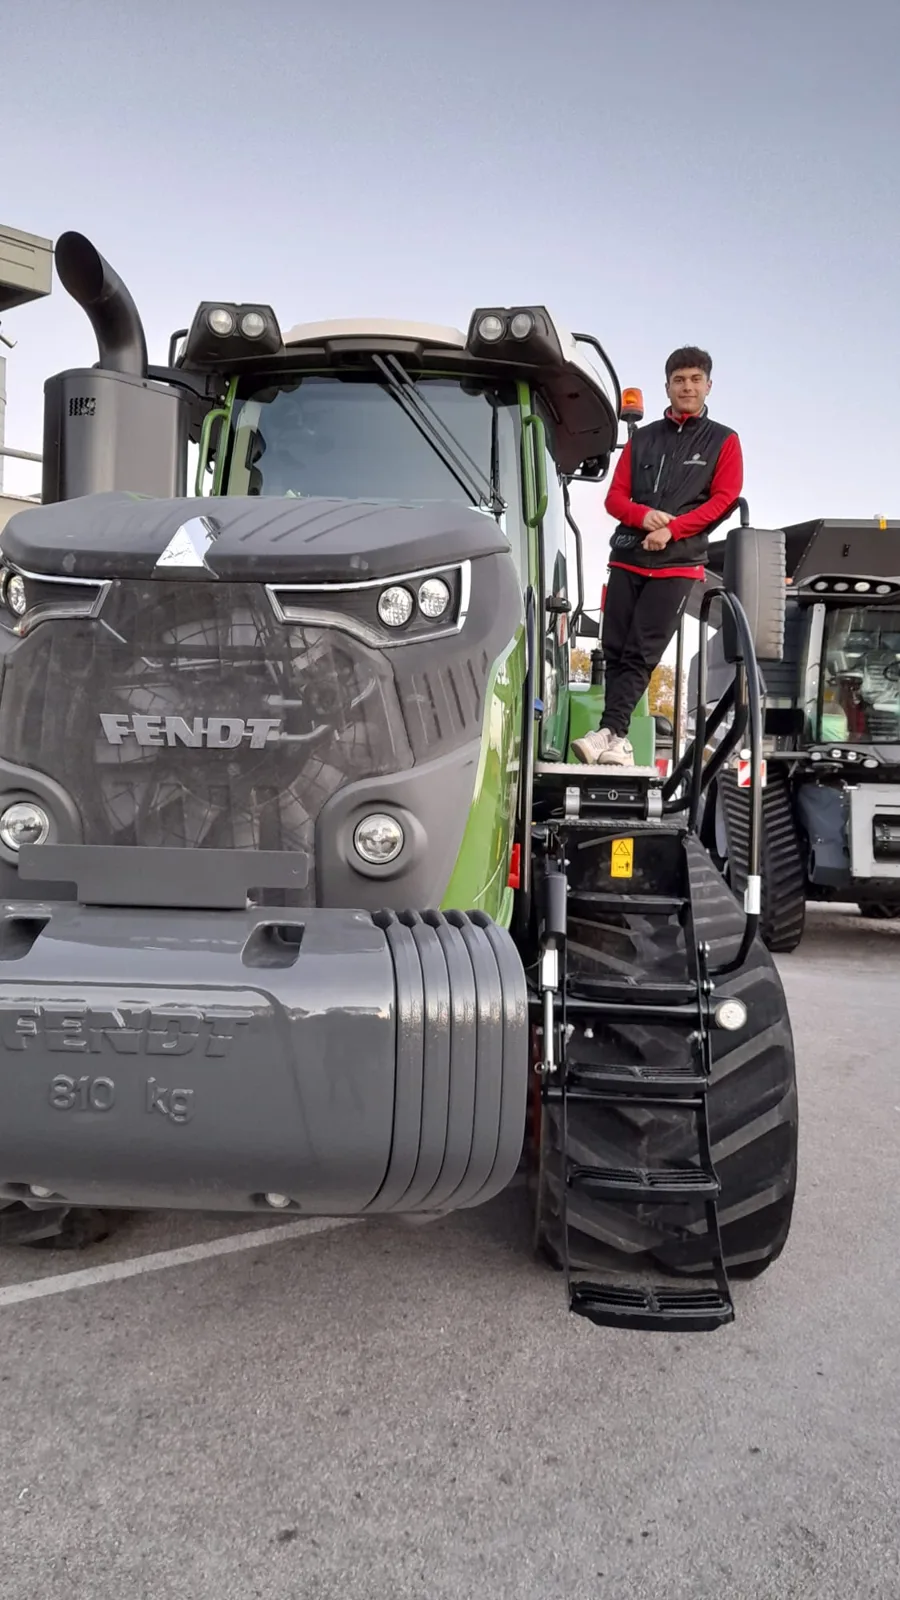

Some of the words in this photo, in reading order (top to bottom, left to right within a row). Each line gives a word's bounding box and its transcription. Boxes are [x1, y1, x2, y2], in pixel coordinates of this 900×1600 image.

[99, 713, 282, 749] FENDT
[0, 1000, 254, 1058] FENDT
[50, 1073, 115, 1112] 810
[147, 1076, 195, 1125] kg
